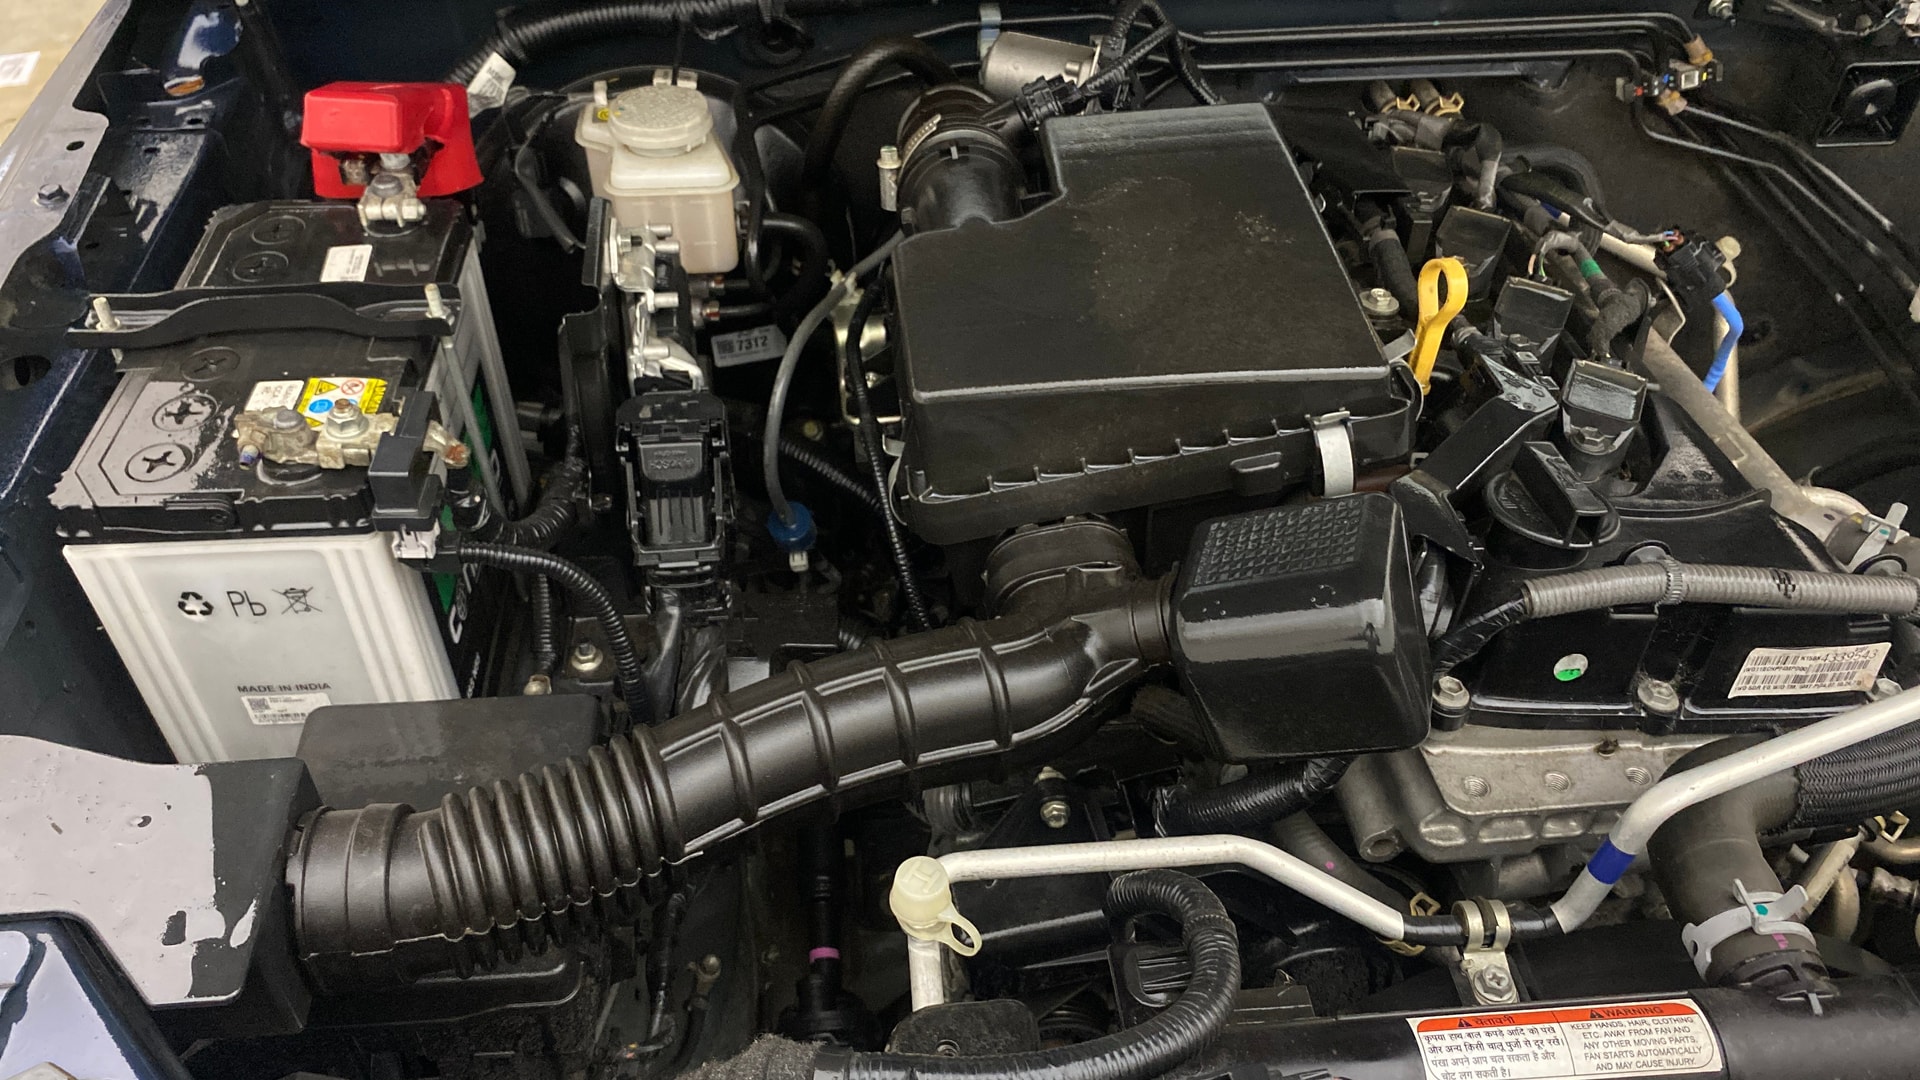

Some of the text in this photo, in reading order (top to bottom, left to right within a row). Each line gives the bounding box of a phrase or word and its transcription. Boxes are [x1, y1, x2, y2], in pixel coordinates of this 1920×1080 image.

[226, 590, 267, 617] Pb
[237, 684, 274, 693] MADE
[296, 682, 331, 691] INDIA
[1603, 1006, 1664, 1018] WARNING
[1475, 1015, 1517, 1027] चेतावनी
[1570, 1016, 1694, 1030] KEEP HANDS, HAIR, CLOTHING
[1423, 1033, 1446, 1045] कृपया
[1449, 1032, 1463, 1042] हाथ
[1466, 1030, 1482, 1040] बाल
[1508, 1027, 1526, 1037] आदि
[1528, 1026, 1540, 1035] को
[1541, 1025, 1557, 1035] पंखे
[1604, 1030, 1626, 1038] AWAY
[1628, 1029, 1652, 1037] FROM
[1655, 1027, 1671, 1035] FAN
[1673, 1026, 1691, 1034] AND
[1428, 1043, 1443, 1054] और
[1445, 1044, 1462, 1053] अन्य
[1464, 1040, 1485, 1052] किसी
[1486, 1041, 1505, 1052] चालू
[1523, 1038, 1532, 1048] से
[1533, 1040, 1544, 1050] दूर
[1583, 1042, 1600, 1050] ANY
[1602, 1040, 1630, 1048] OTHER
[1633, 1038, 1667, 1047] MOVING
[1431, 1050, 1556, 1068] पंखा अपने आप चल सकता है और
[1584, 1046, 1702, 1061] FAN STARTS AUTOMATICALLY
[1596, 1057, 1697, 1071] AND MAY CAUSE INJURY.
[1441, 1071, 1457, 1080] चोट
[1458, 1070, 1473, 1080] लग
[1475, 1067, 1499, 1078] सकती
